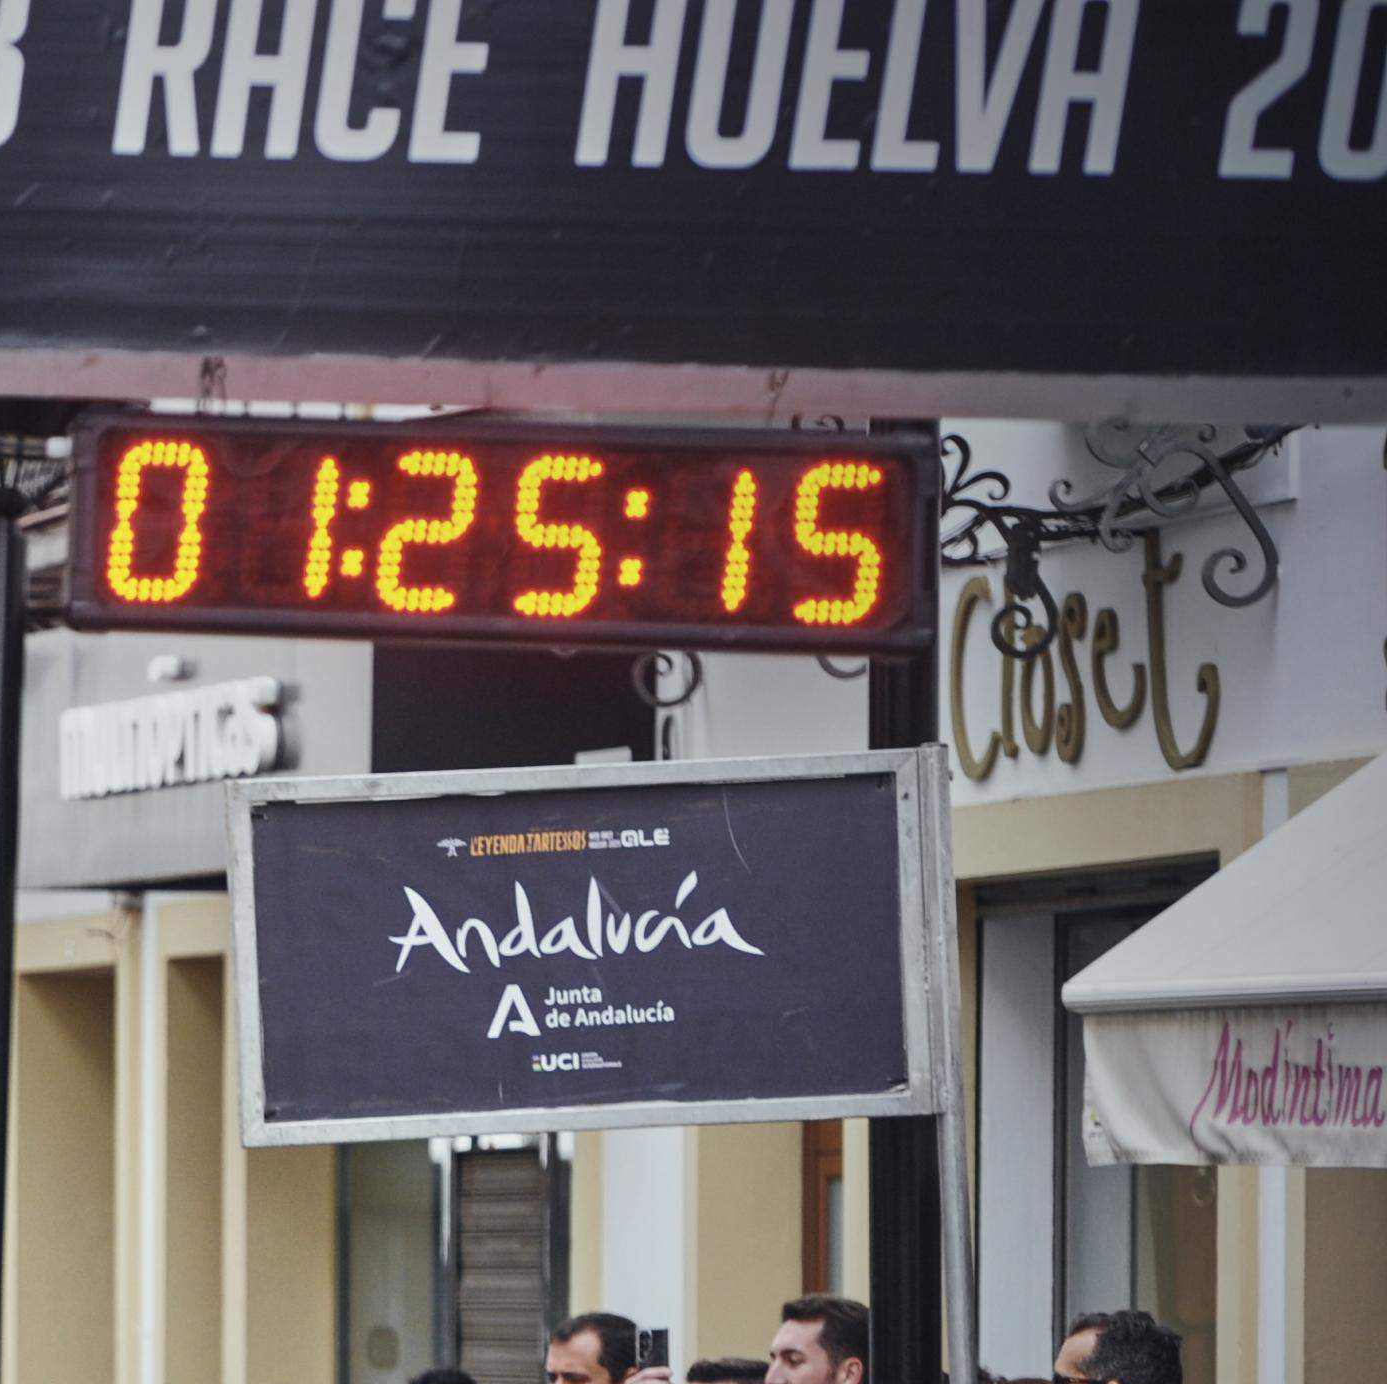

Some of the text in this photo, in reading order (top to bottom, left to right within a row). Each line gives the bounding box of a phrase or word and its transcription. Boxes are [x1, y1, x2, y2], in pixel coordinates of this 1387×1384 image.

[111, 0, 489, 166] RACE
[574, 0, 1138, 177] HUELVA
[949, 528, 1222, 782] Closet
[470, 834, 526, 857] LEYENDA
[526, 829, 588, 854] TARTESSOS
[388, 869, 766, 974] Andalucía
[544, 985, 603, 1006] Junta
[545, 999, 675, 1029] de Andalucía
[540, 1052, 580, 1072] UCI
